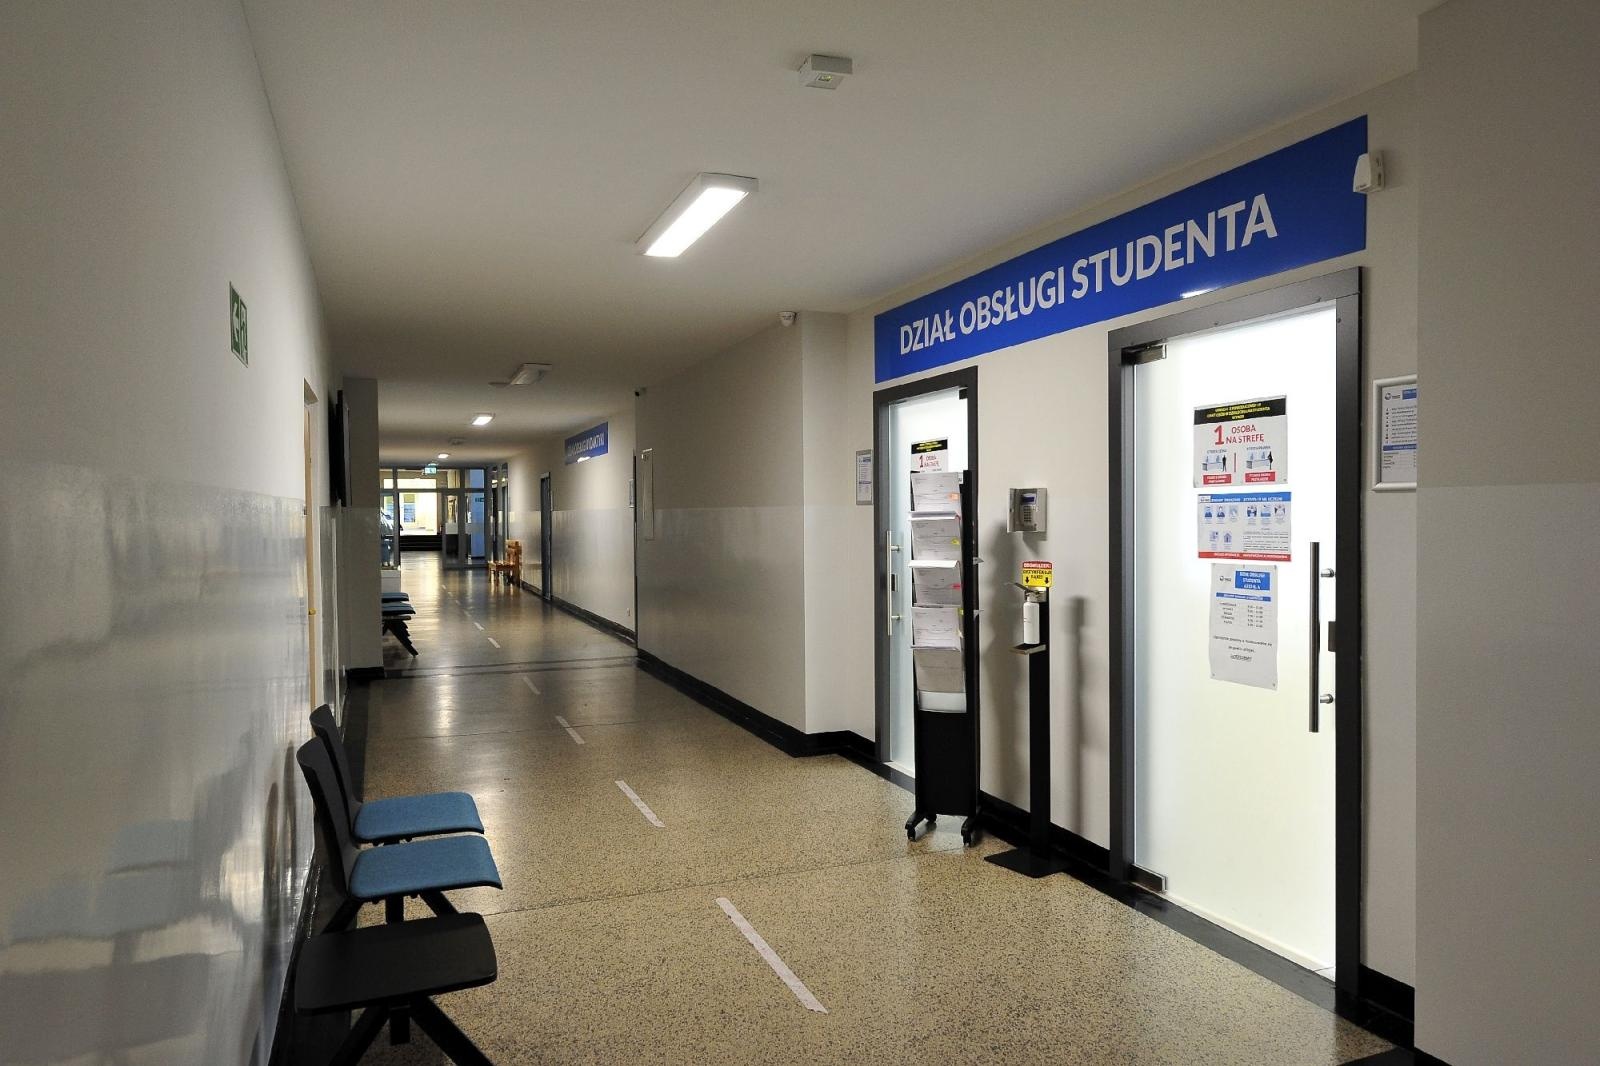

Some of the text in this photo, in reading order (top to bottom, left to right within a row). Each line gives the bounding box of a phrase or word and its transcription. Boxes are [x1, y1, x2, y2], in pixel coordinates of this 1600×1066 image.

[899, 192, 1279, 355] DZIAŁ OBSŁUGI STUDENTA
[1214, 424, 1256, 445] 1 OSOBA
[1226, 433, 1264, 444] NA STREFĘ
